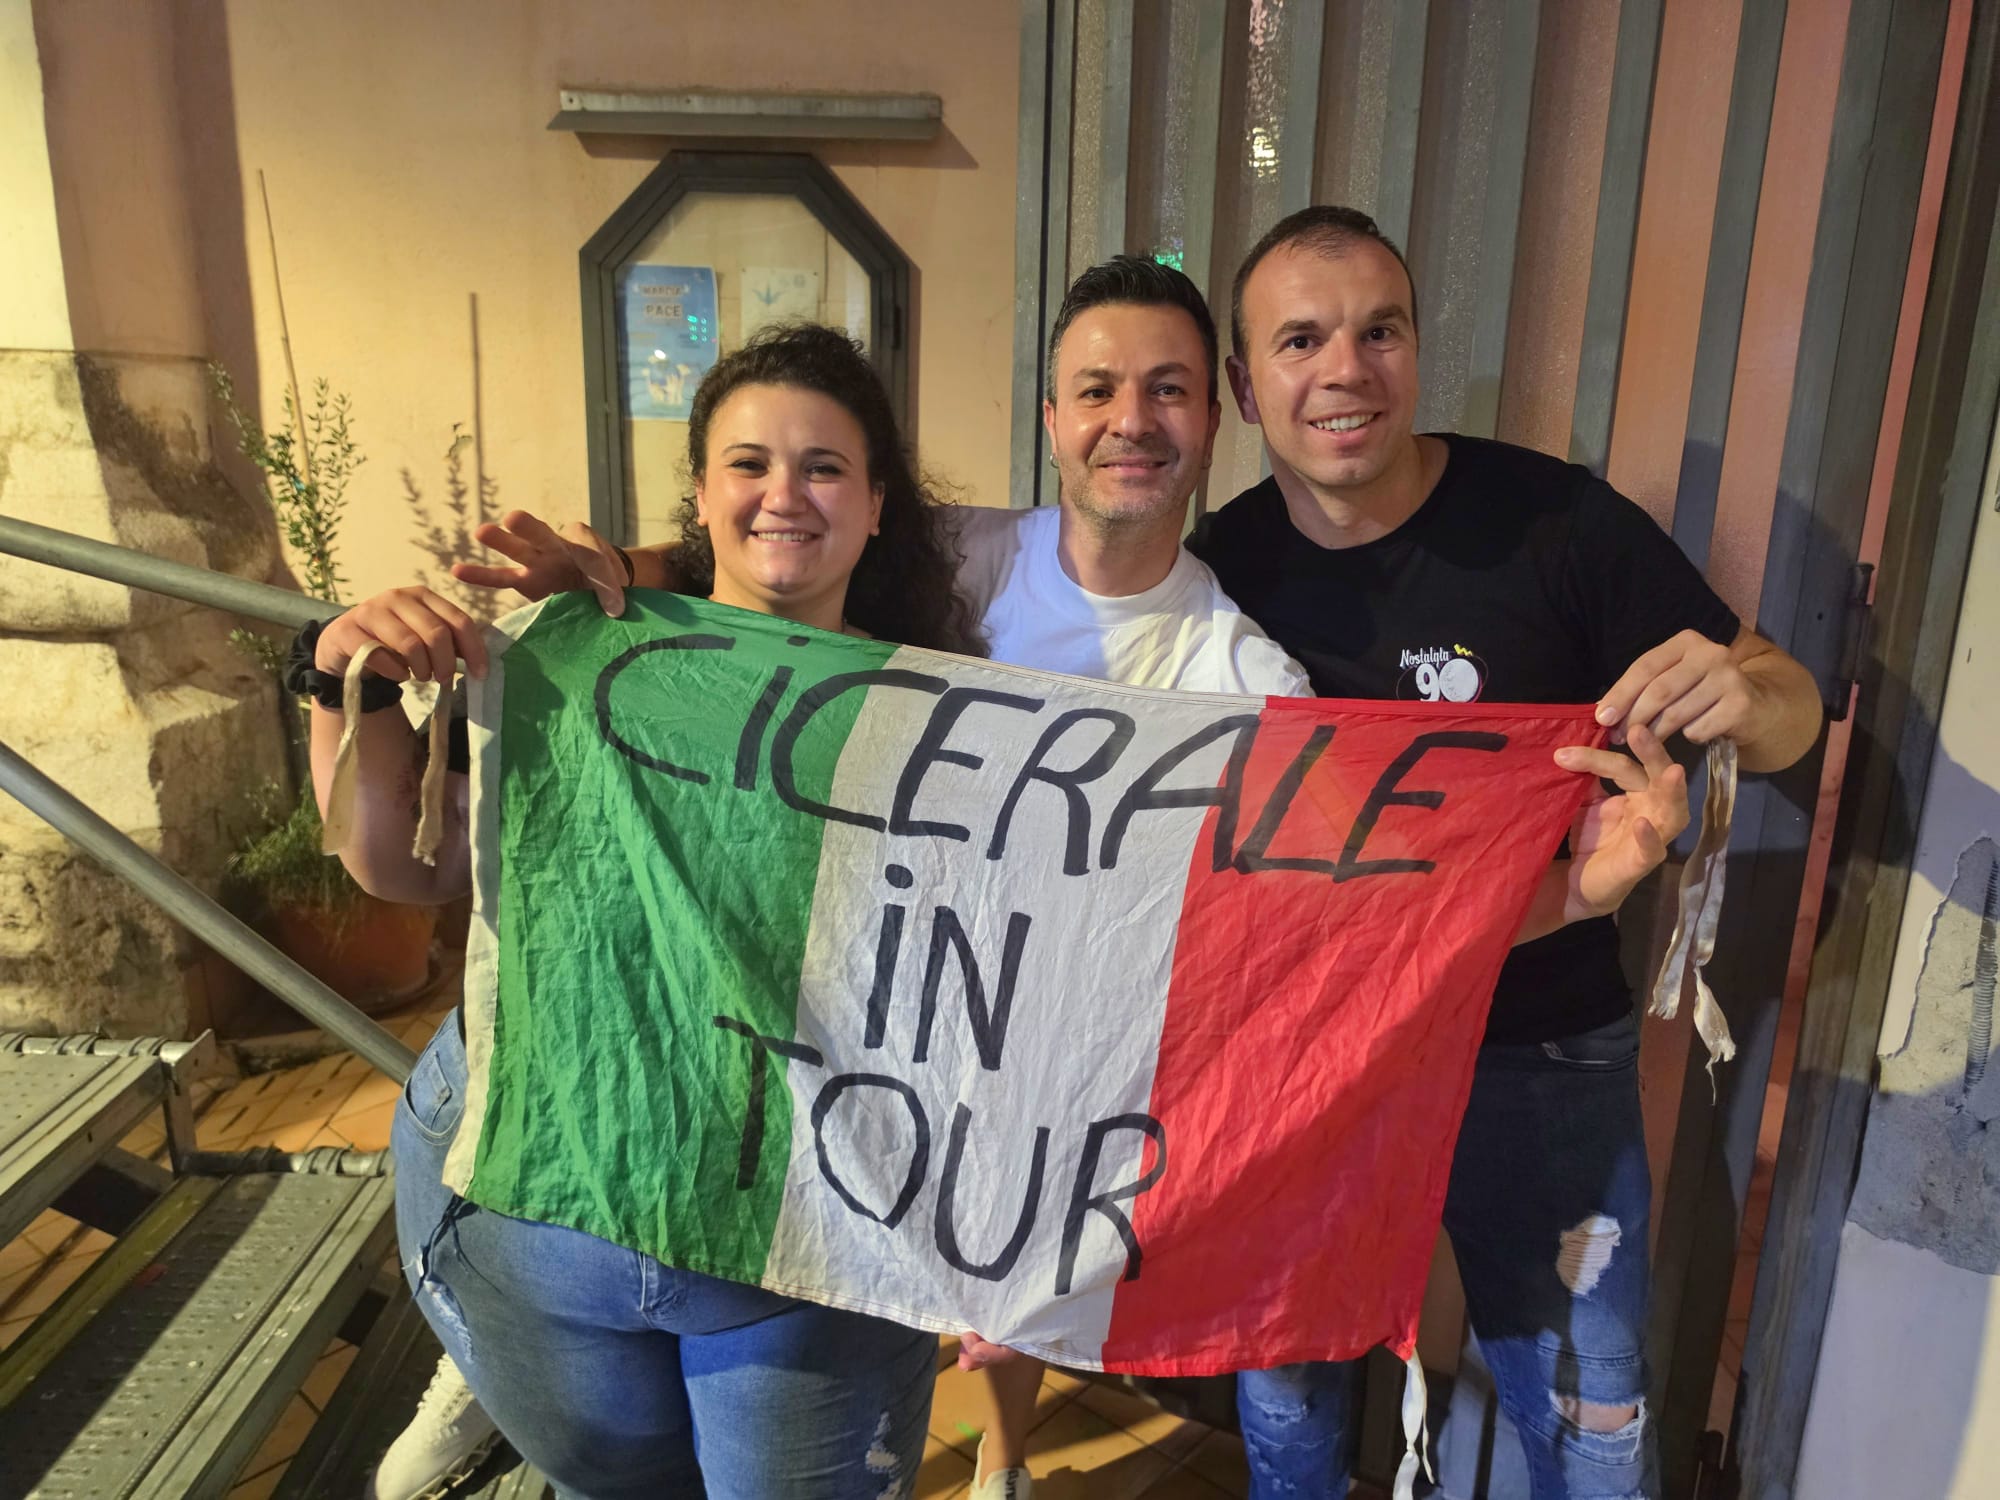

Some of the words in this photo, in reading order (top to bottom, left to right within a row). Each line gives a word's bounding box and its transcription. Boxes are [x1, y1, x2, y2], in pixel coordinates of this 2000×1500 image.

[645, 304, 681, 317] PACE
[1415, 658, 1479, 703] 90
[712, 1015, 1167, 1296] TOUR
